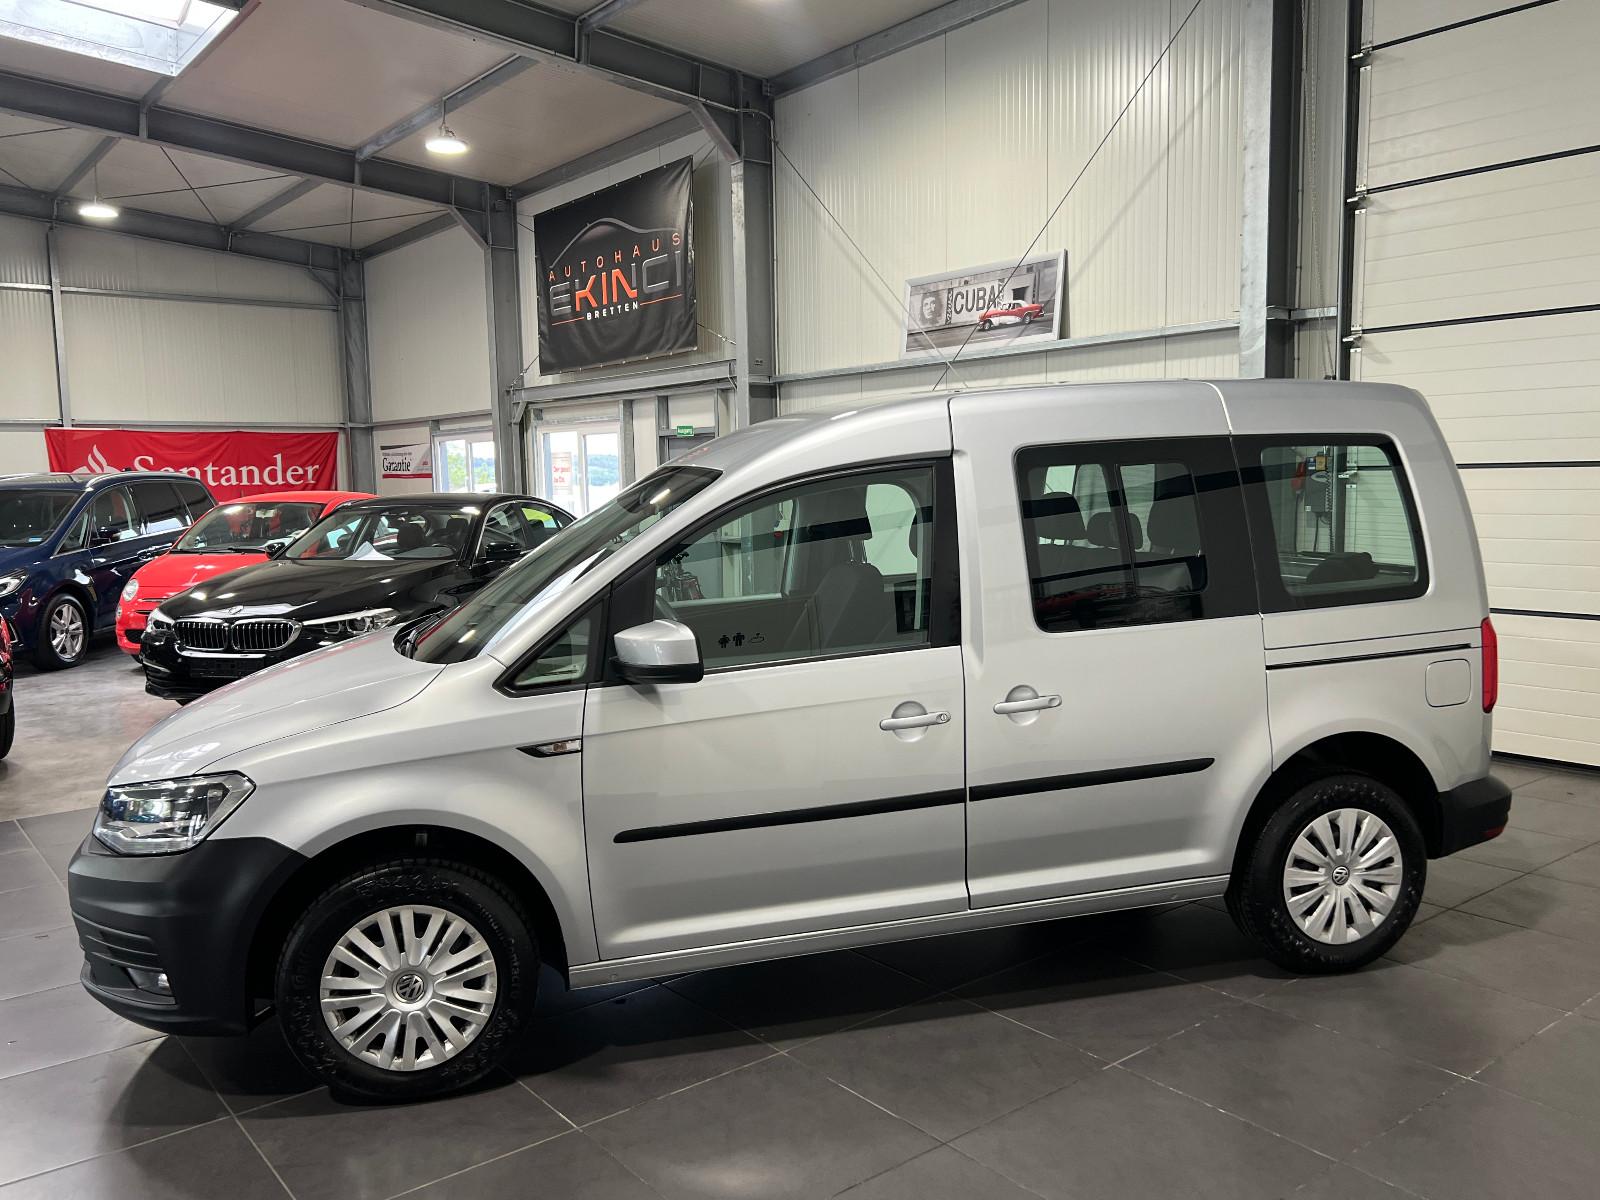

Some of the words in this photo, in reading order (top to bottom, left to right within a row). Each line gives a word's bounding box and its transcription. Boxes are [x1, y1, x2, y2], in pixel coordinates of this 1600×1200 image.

[548, 232, 681, 282] AUTOHAUS
[549, 251, 682, 317] EKINCI
[954, 285, 997, 314] CUBA
[587, 303, 639, 321] BRETTEN
[134, 453, 320, 486] Sntander
